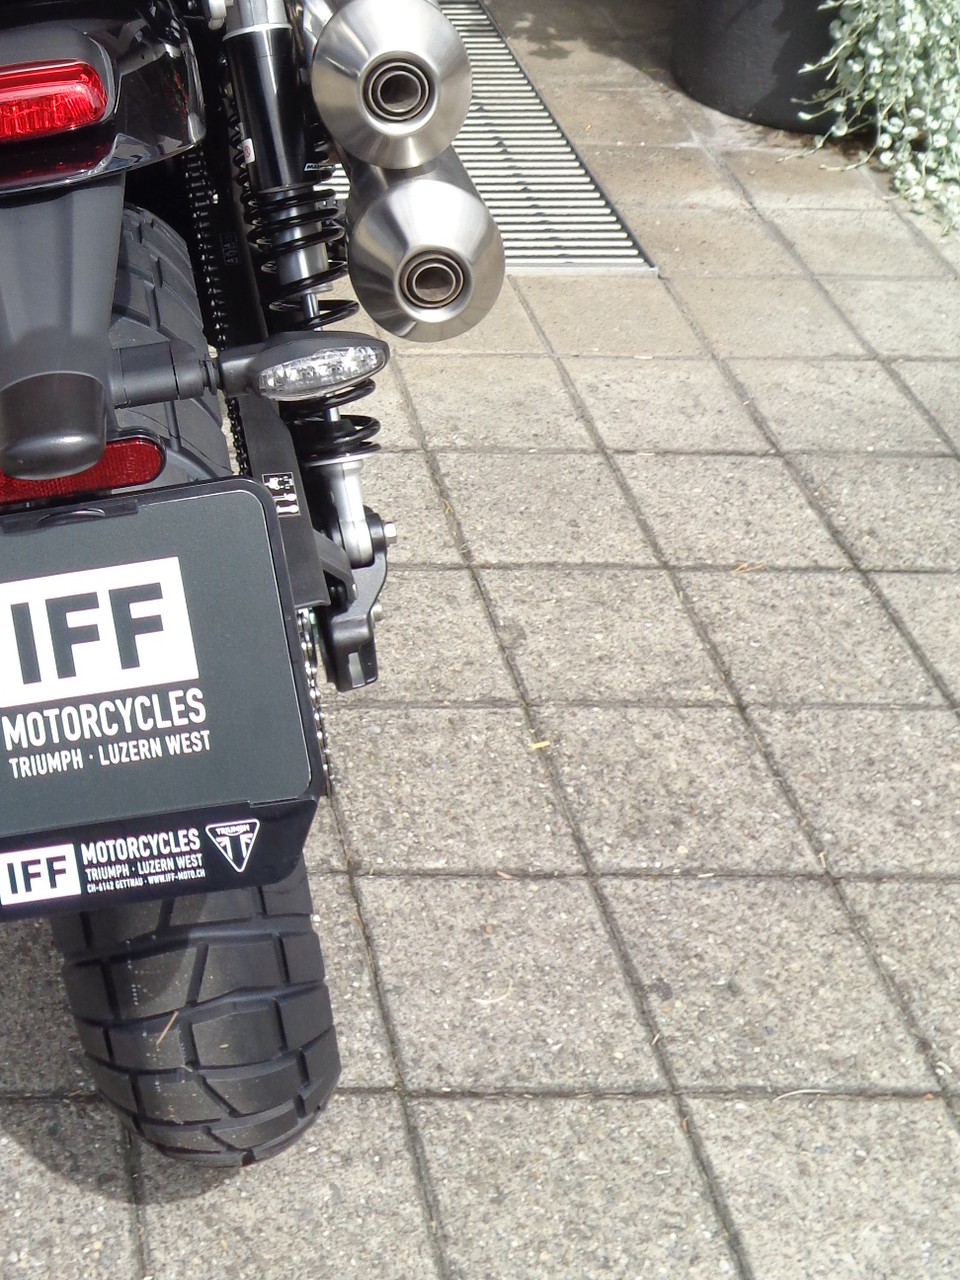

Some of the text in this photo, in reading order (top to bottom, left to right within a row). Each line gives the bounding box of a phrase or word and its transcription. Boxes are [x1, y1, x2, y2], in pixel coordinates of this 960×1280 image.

[10, 582, 164, 685] IFF
[1, 687, 207, 751] MOTORCYCLES
[9, 730, 211, 779] TRIUMPH LUZERN WEST
[80, 827, 201, 866] MOTORCYCLES
[215, 824, 251, 836] TRIUMPH
[7, 855, 68, 895] IFF
[85, 853, 204, 882] TRIUMPH LUZERN WEST
[115, 877, 144, 890] GETTNAU
[147, 868, 206, 885] WWW.IFF-MOTO.CH
